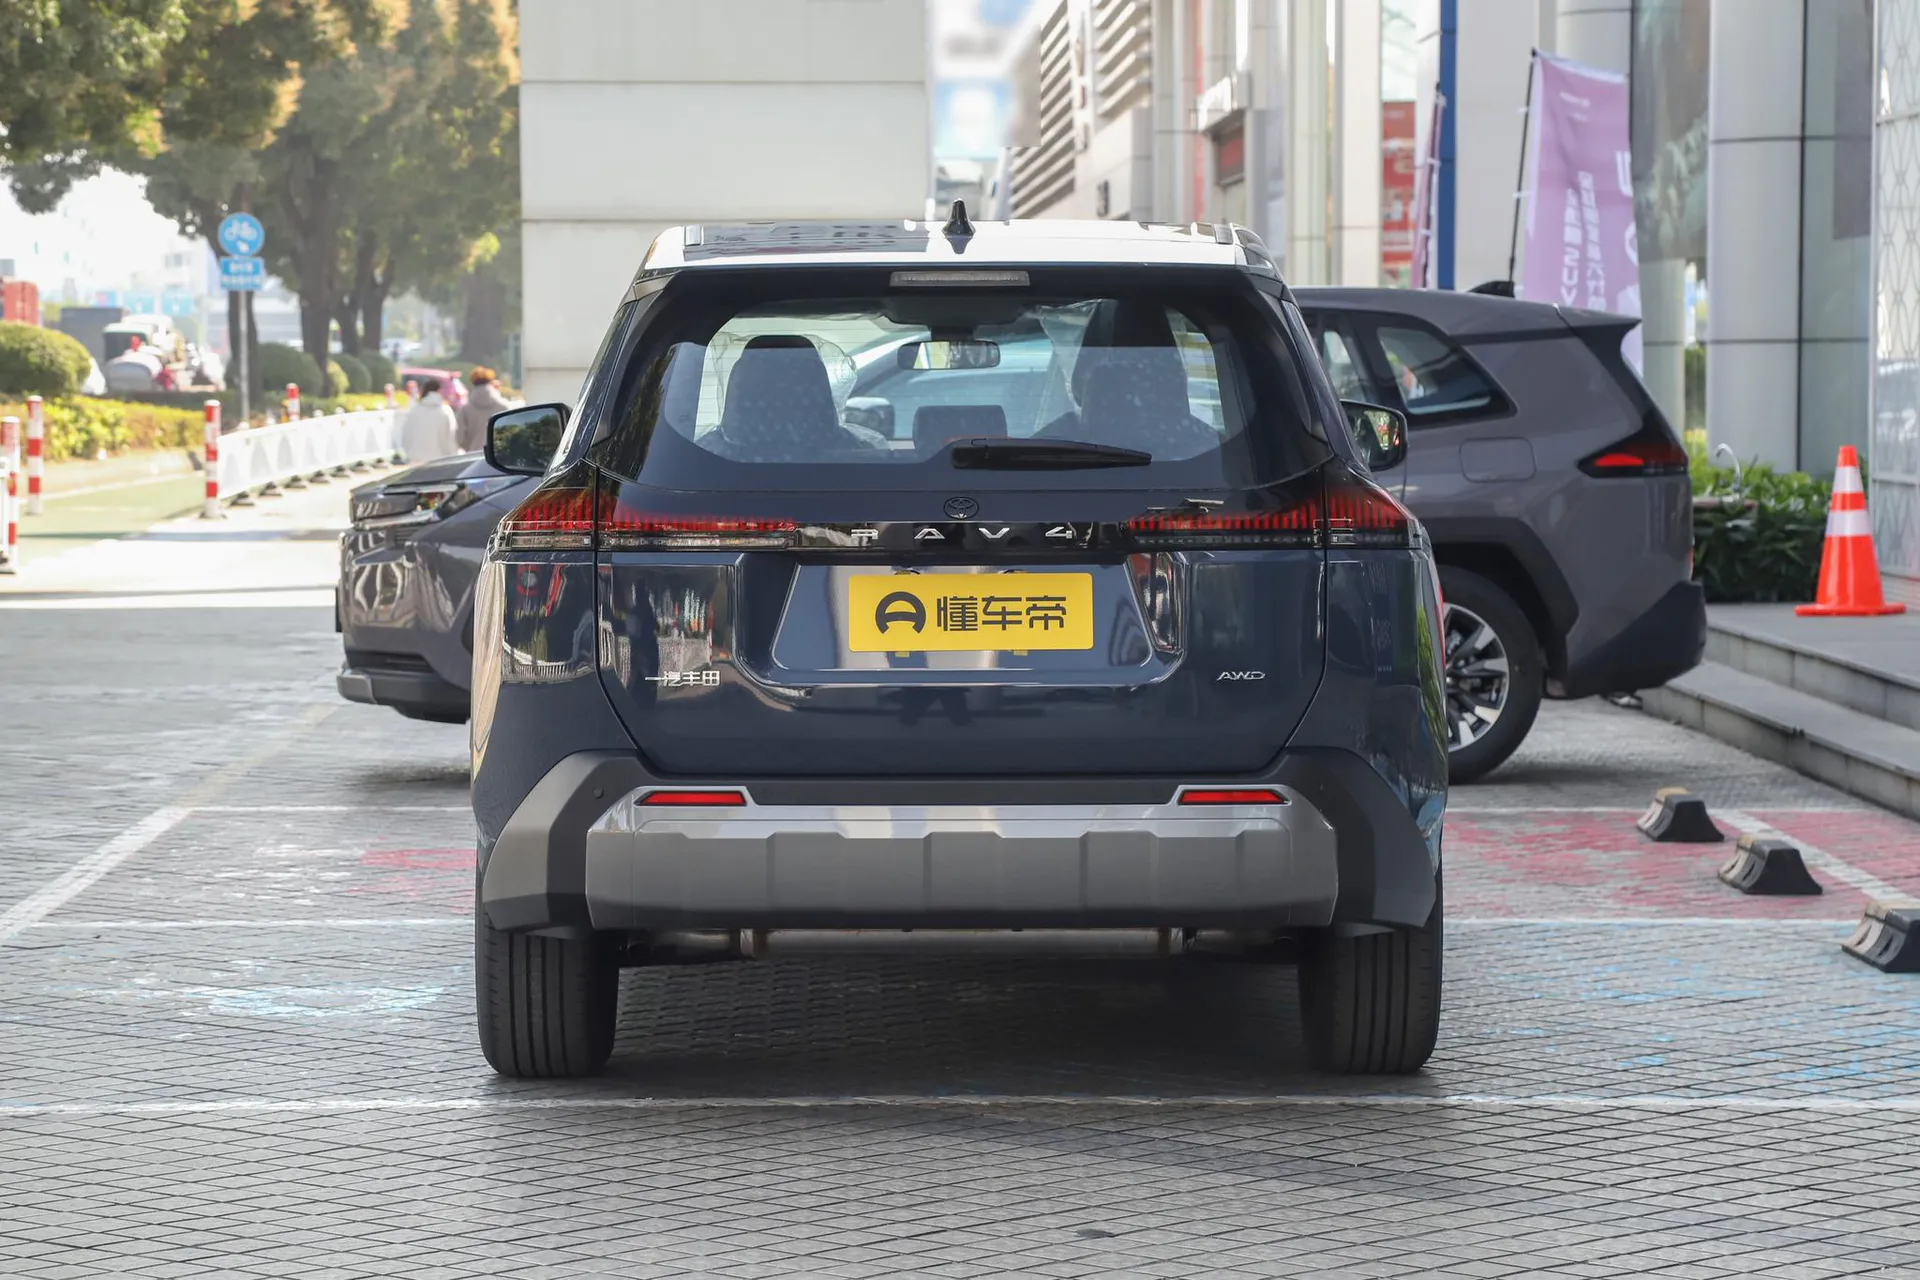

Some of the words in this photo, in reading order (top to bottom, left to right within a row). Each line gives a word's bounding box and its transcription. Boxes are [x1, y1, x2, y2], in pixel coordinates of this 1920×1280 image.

[851, 527, 1072, 540] RAV4
[936, 595, 1067, 632] 懂车帝
[645, 670, 721, 686] 一汽丰田
[1216, 671, 1266, 681] AWD
